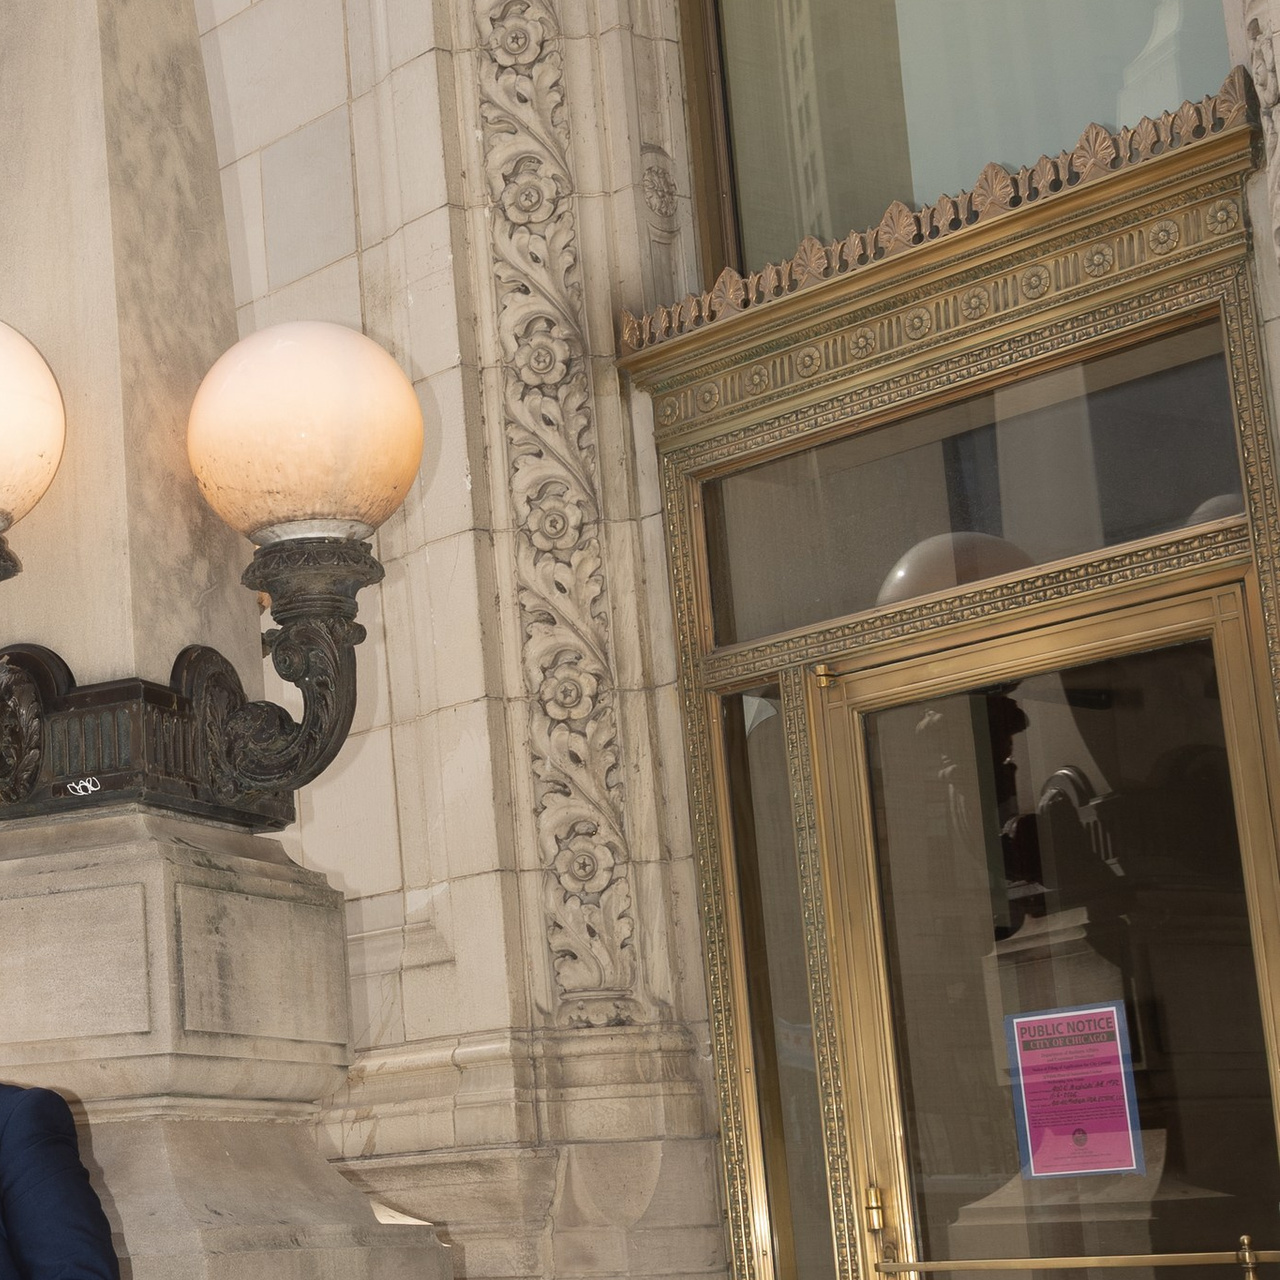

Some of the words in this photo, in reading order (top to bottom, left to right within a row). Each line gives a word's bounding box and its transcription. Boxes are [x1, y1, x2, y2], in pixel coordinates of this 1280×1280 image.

[1020, 1023, 1064, 1038] PUBLIC
[1067, 1017, 1114, 1033] NOTICE
[1030, 1040, 1050, 1049] CITY
[1052, 1037, 1065, 1047] OF
[1066, 1033, 1107, 1045] CHICAGO
